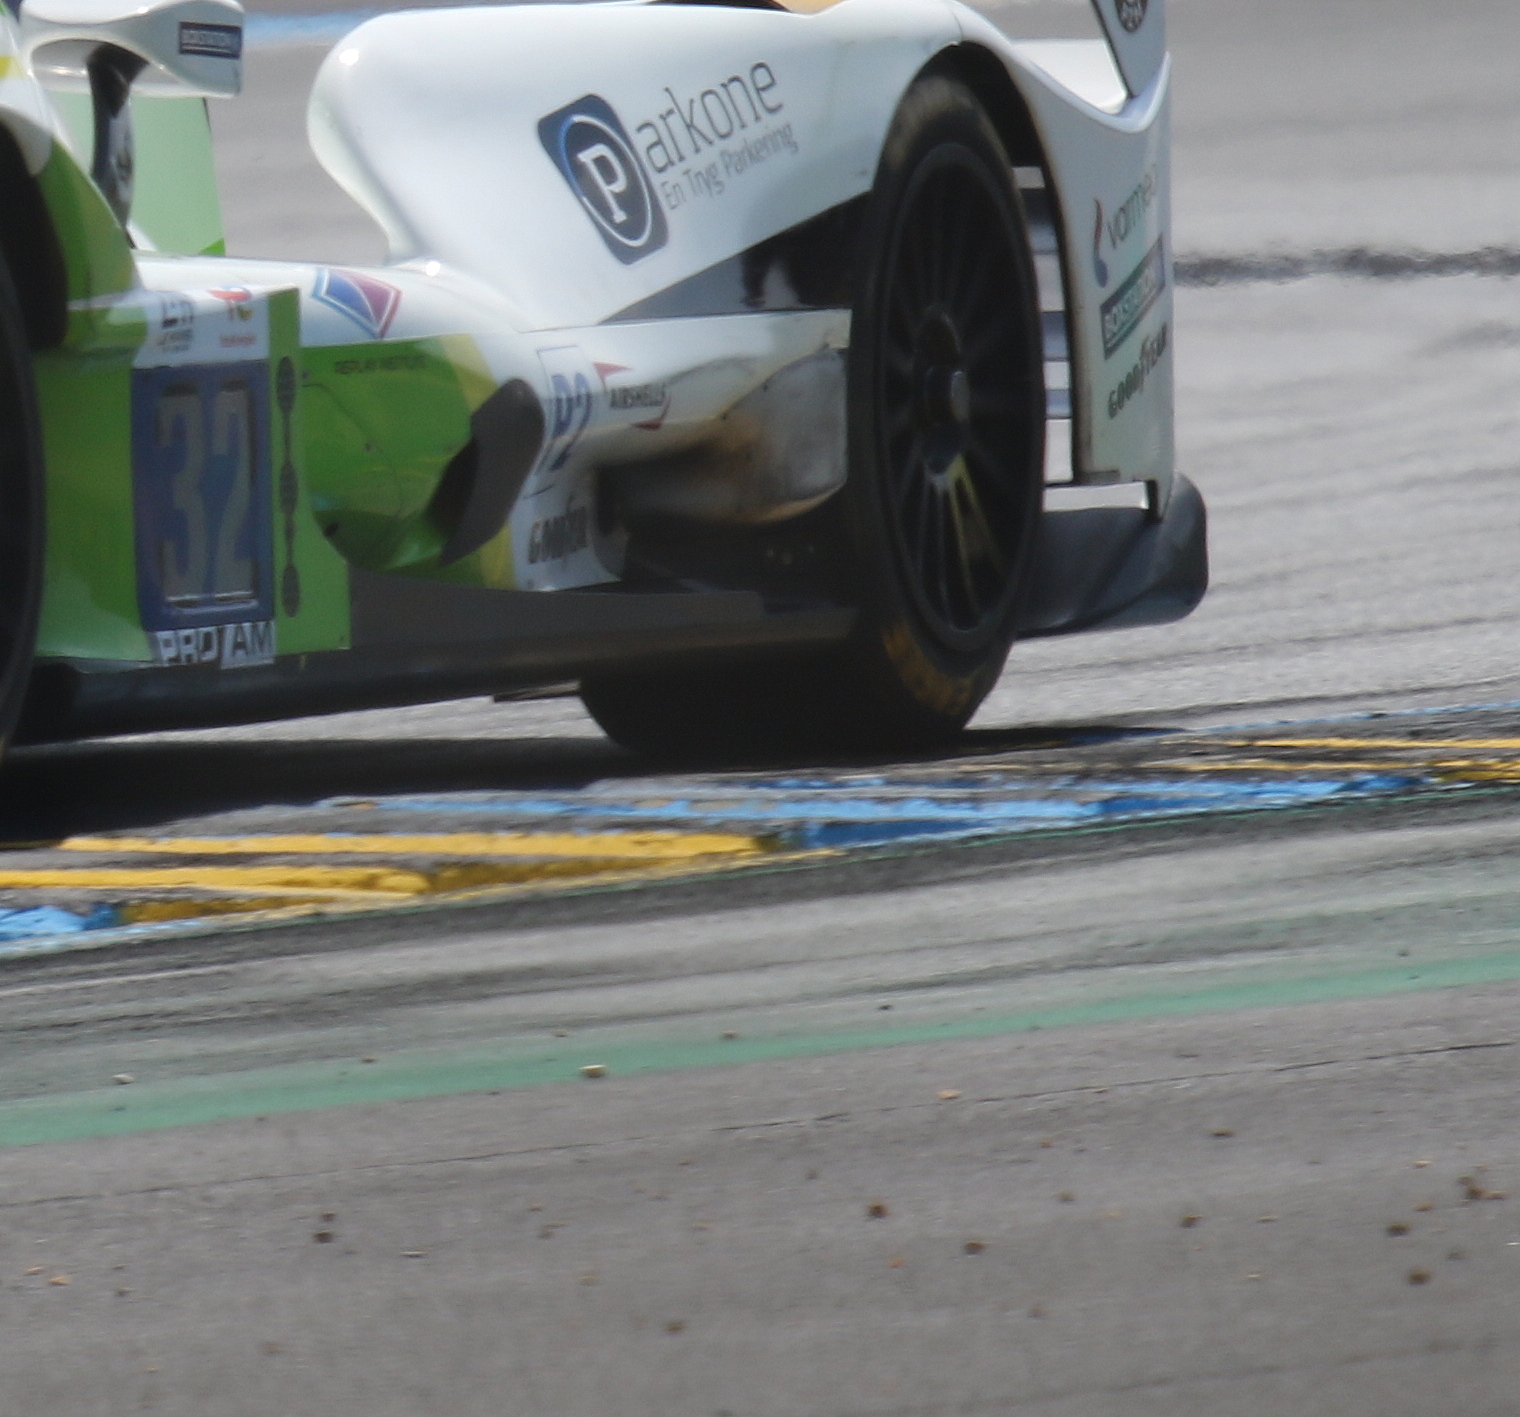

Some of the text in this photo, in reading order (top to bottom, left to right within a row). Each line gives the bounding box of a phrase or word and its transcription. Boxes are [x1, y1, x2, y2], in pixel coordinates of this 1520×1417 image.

[661, 179, 686, 210] En
[683, 163, 725, 198] Tryg
[160, 382, 255, 605] 32
